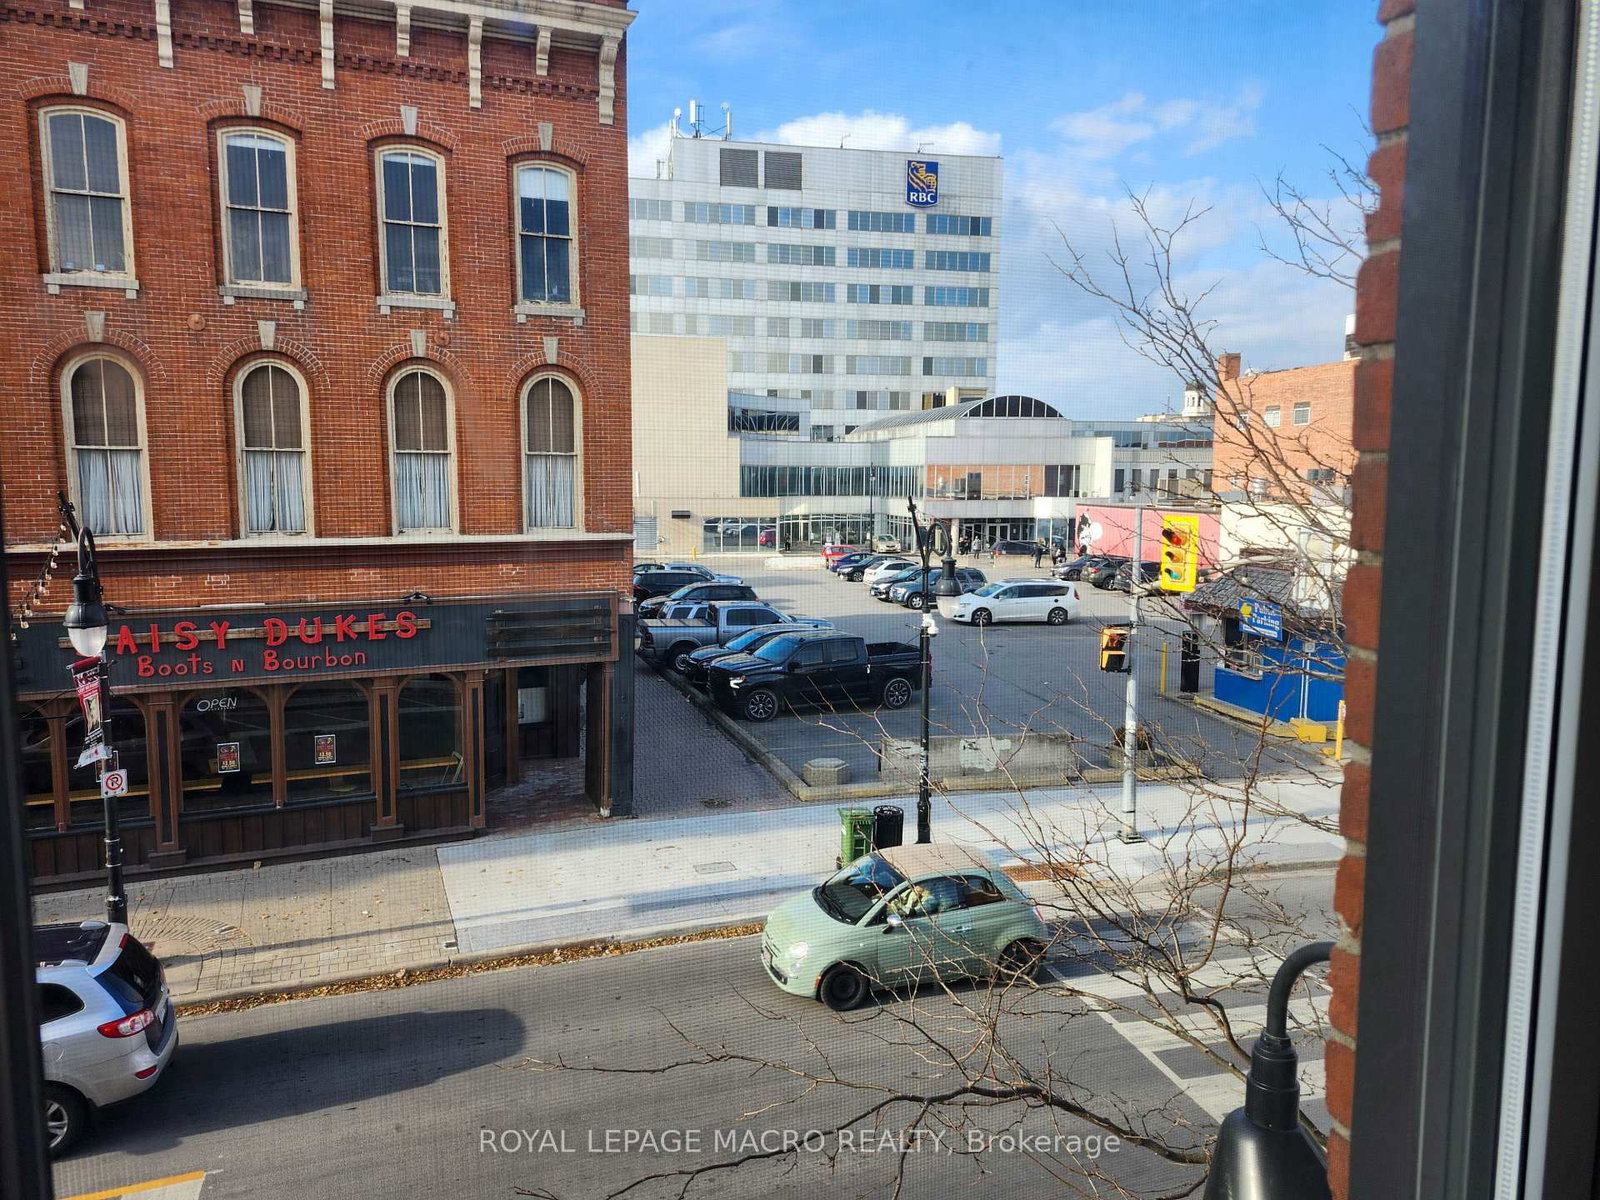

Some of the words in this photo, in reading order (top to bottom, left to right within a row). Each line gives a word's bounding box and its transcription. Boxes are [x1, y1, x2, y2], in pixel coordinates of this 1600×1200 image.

[909, 192, 936, 203] RBC
[74, 620, 230, 656] AISY
[263, 611, 418, 646] DUKES
[137, 653, 213, 677] Boots
[263, 646, 367, 671] Bourbon
[196, 697, 237, 712] OPEN
